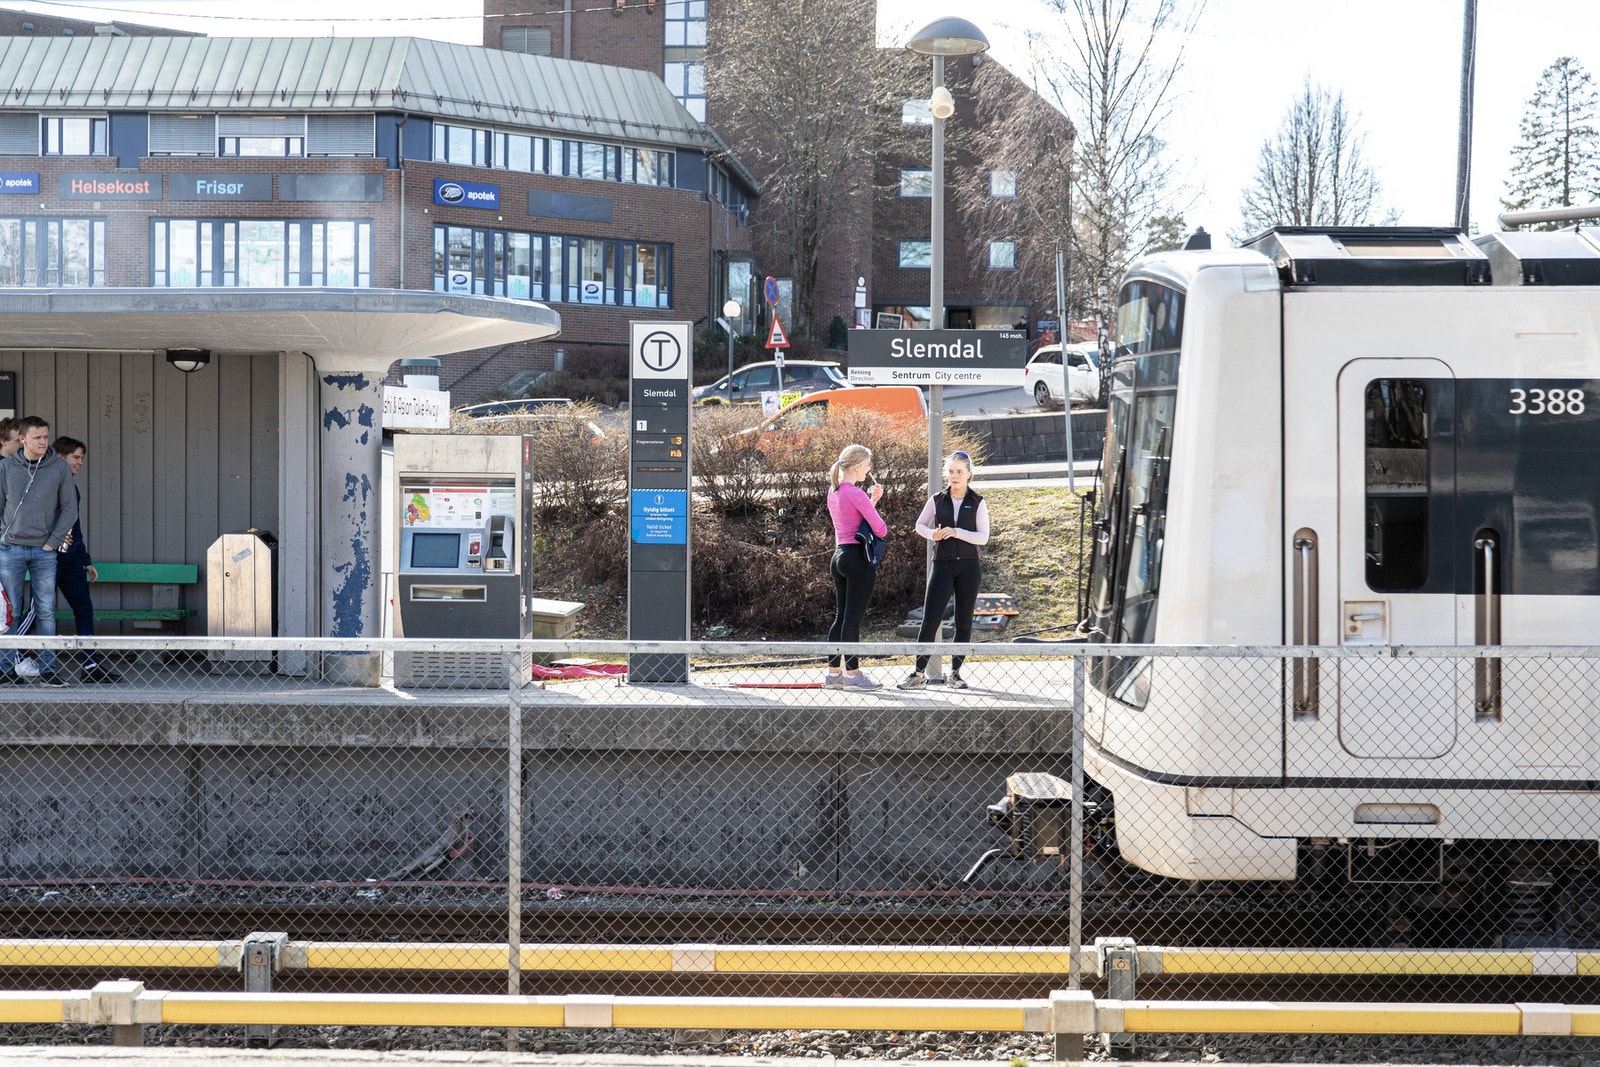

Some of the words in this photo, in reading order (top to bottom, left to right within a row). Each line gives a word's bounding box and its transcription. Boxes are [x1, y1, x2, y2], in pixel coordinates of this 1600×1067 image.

[5, 178, 33, 188] apotek
[71, 179, 150, 194] Helsekost
[196, 180, 244, 195] Frisør
[467, 191, 496, 201] apotek
[890, 338, 984, 358] Slemdal
[892, 371, 931, 379] Sentrum
[934, 371, 952, 381] City
[953, 372, 982, 380] centre
[643, 388, 677, 398] Slemdal
[1508, 388, 1586, 415] 3388
[675, 436, 682, 445] 3
